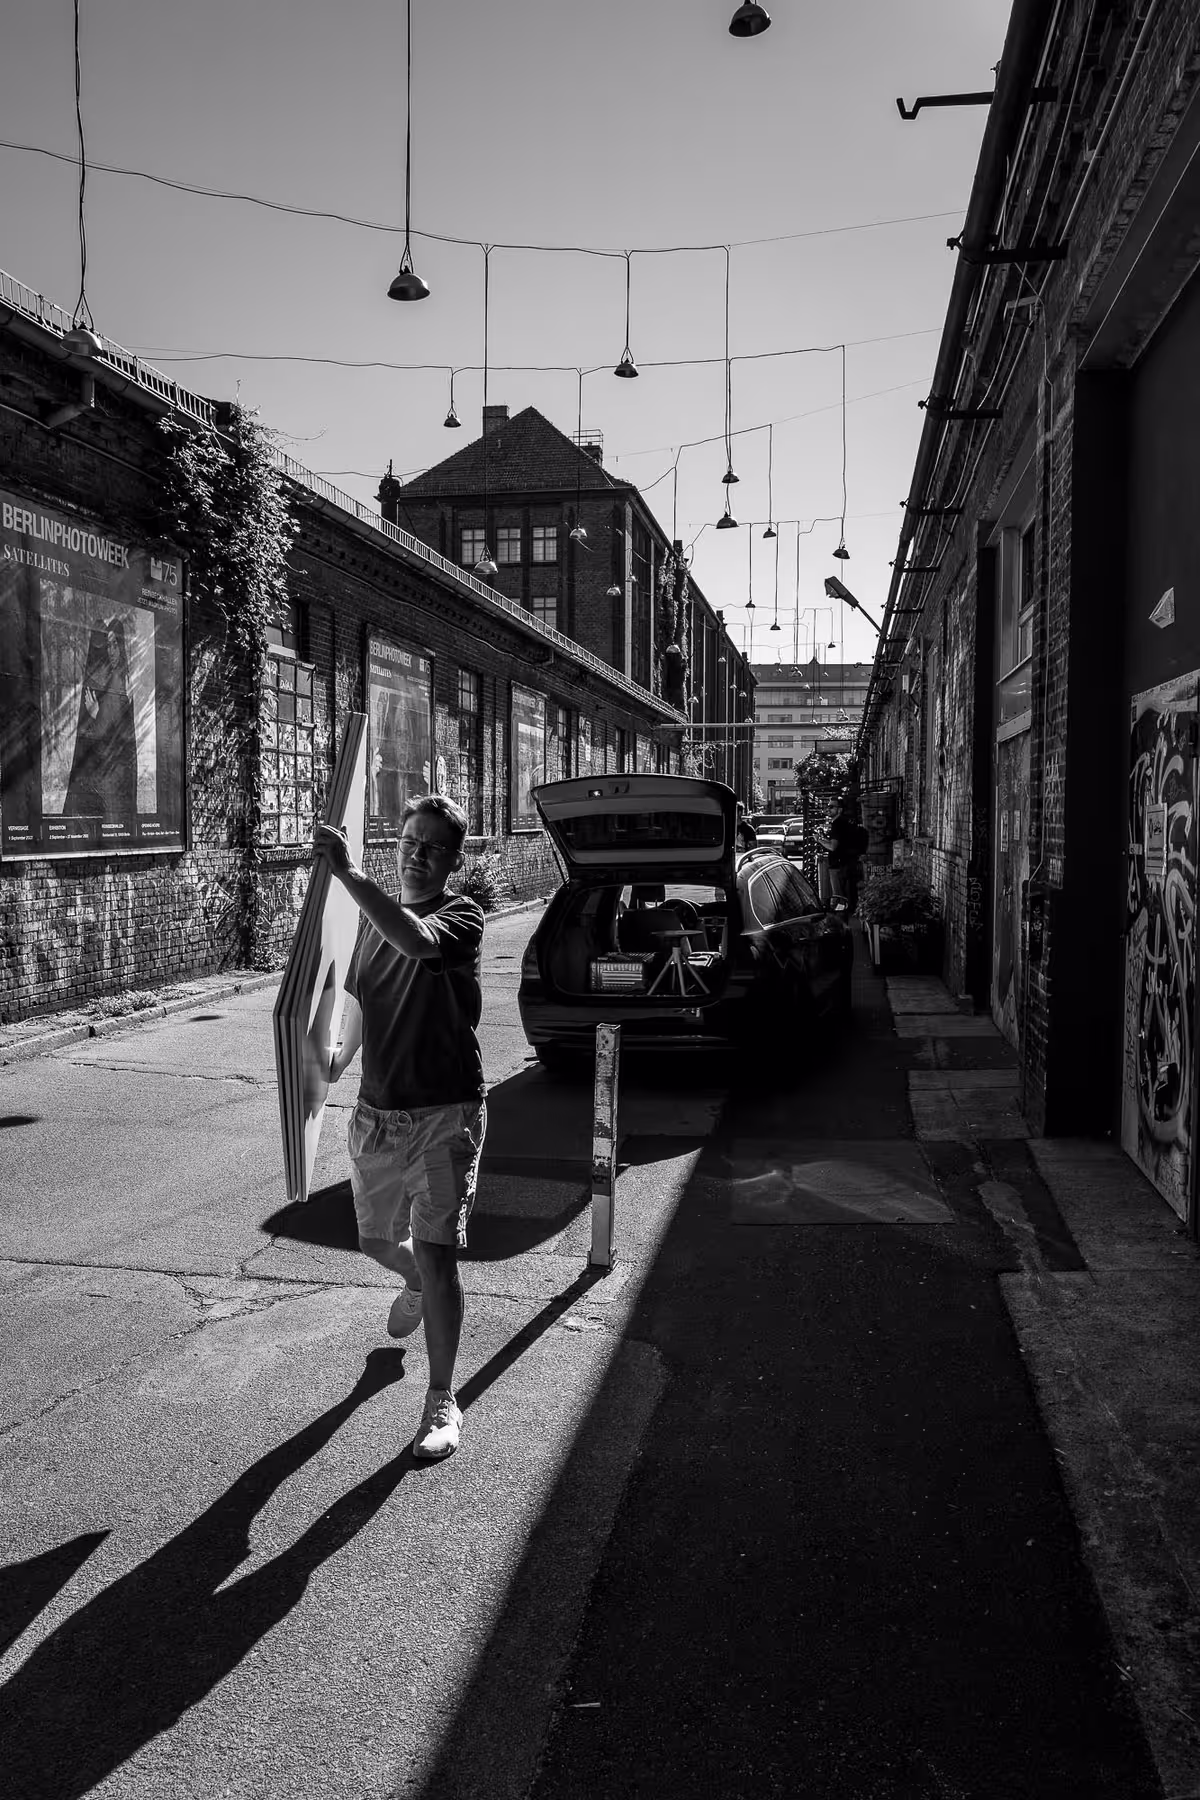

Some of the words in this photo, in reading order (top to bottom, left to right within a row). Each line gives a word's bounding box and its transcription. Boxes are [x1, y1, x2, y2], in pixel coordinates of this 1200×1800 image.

[3, 502, 129, 569] BERLINPHOTOWEEK
[4, 543, 70, 577] SATELLITES
[162, 561, 178, 586] 75
[370, 640, 412, 667] BERLINPHOTOWEEK
